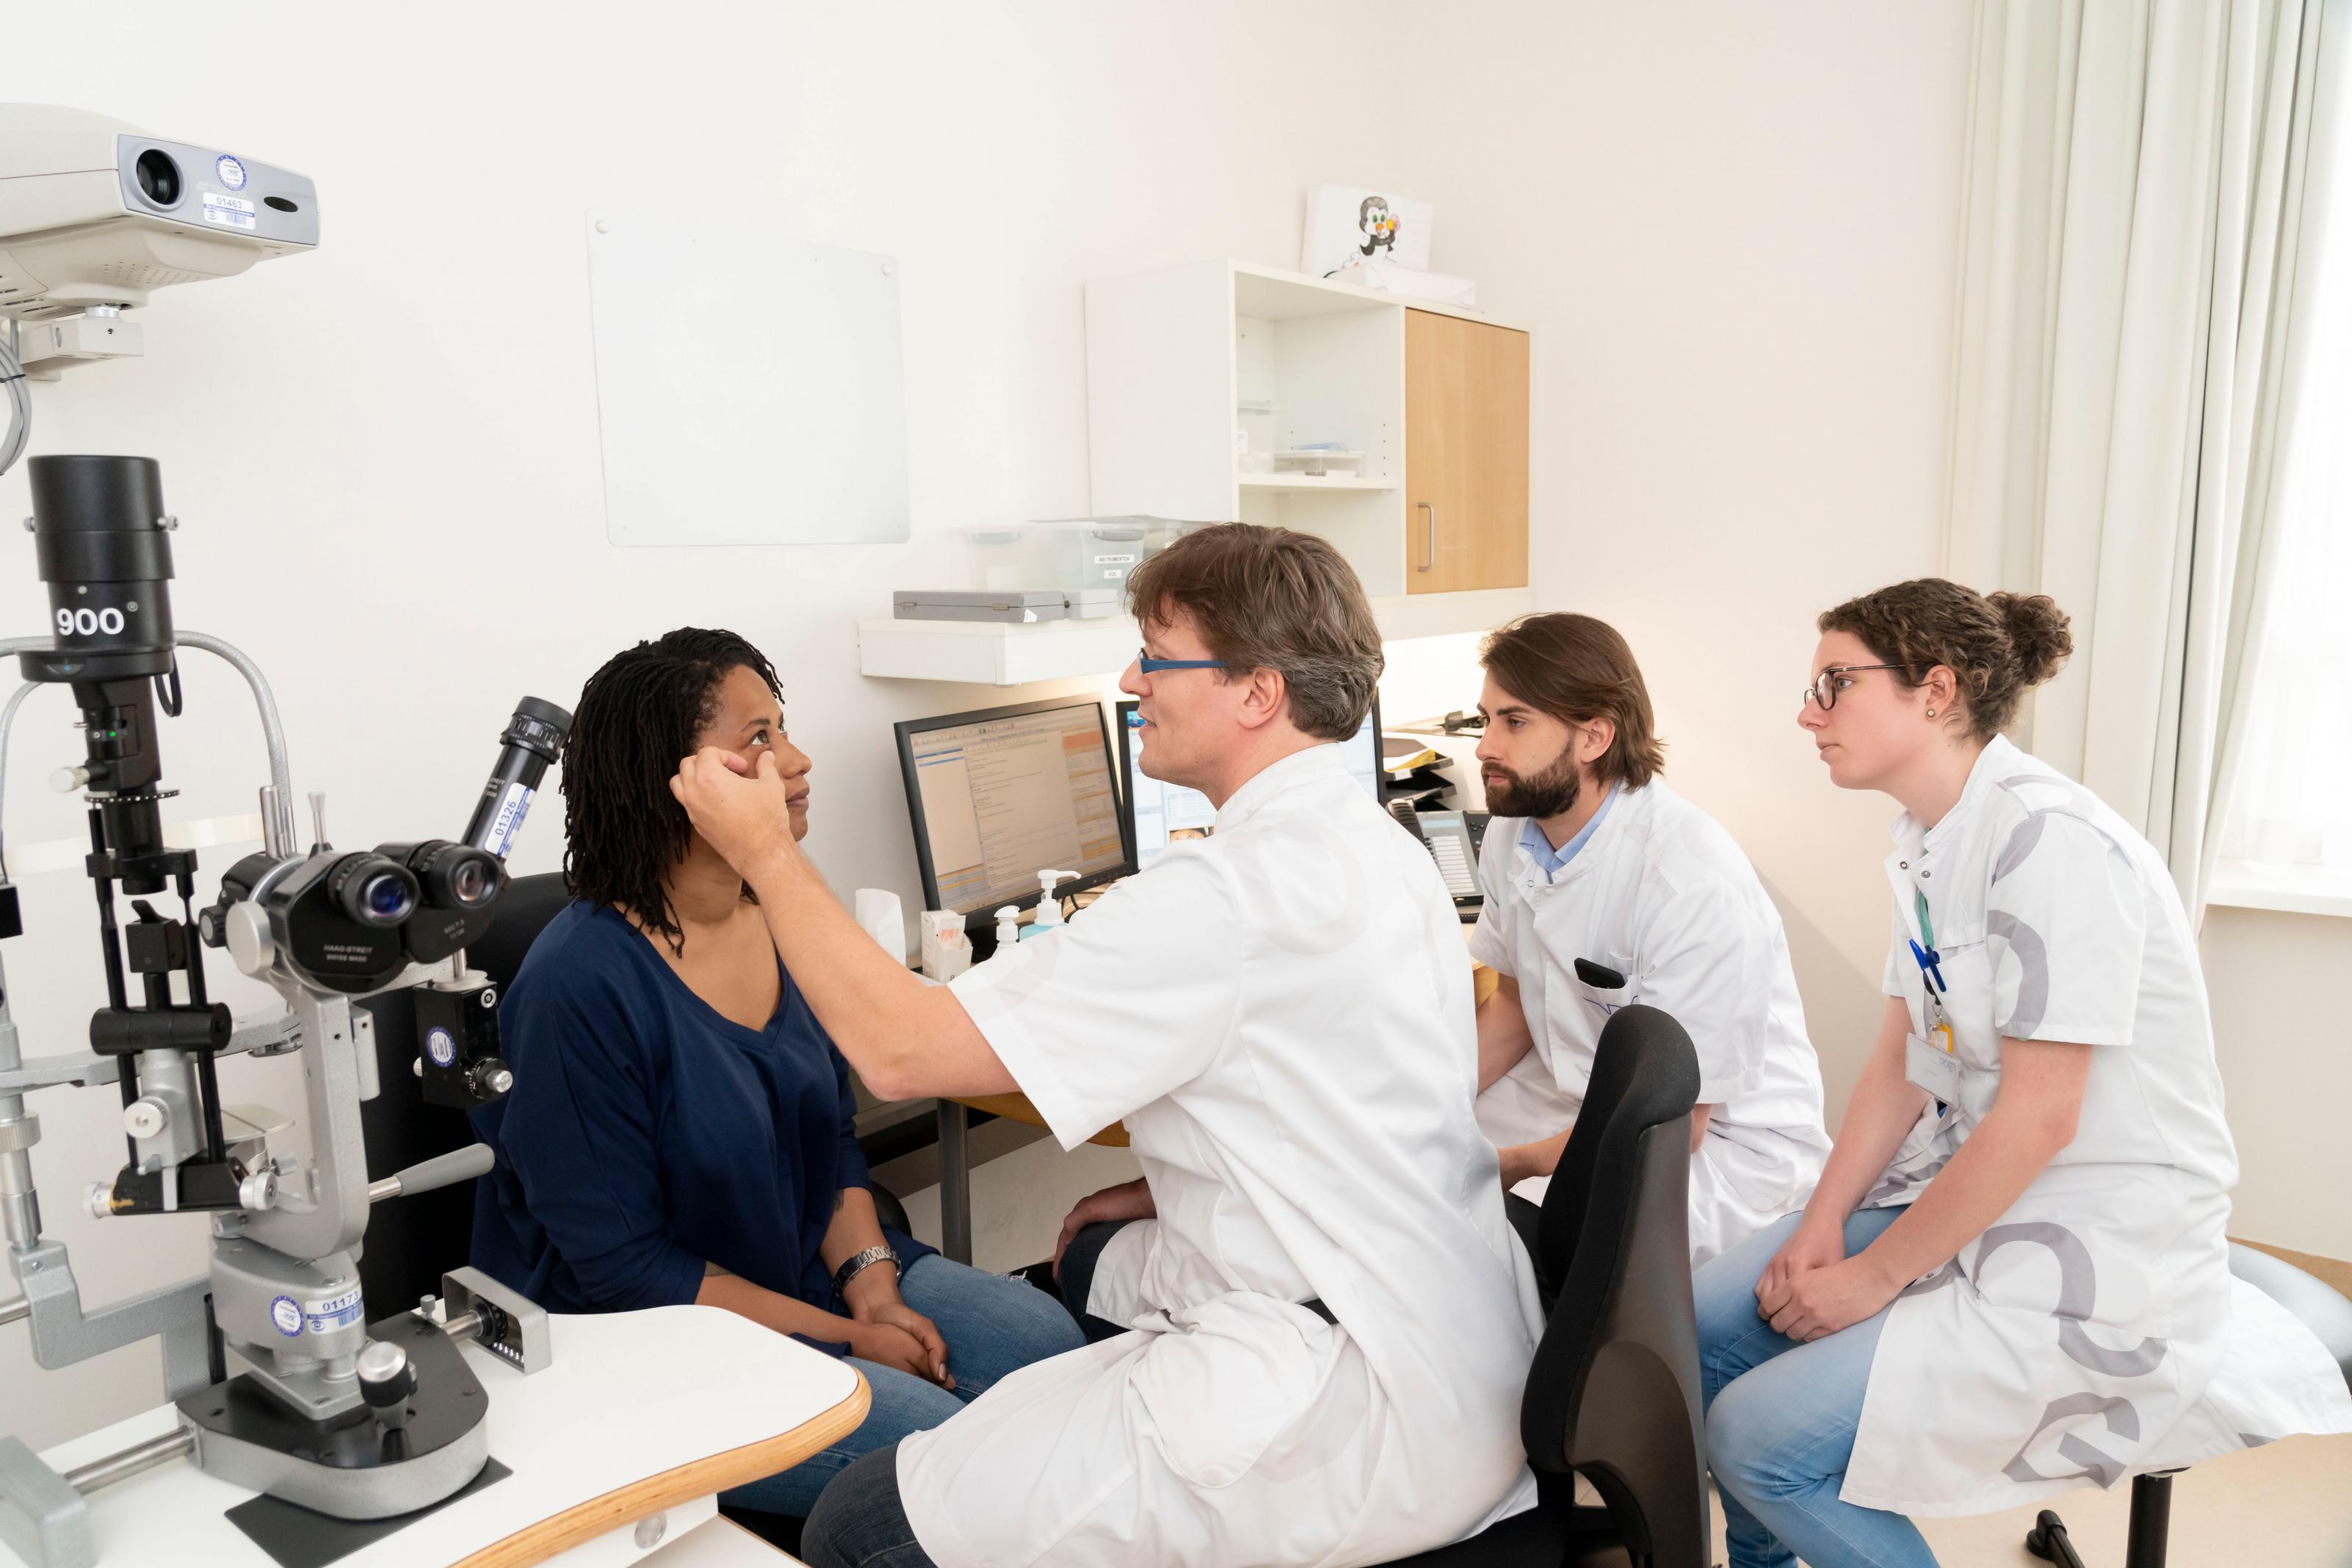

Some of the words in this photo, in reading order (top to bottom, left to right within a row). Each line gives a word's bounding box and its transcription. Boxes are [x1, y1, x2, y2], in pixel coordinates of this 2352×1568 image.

[217, 197, 243, 209] 01463
[57, 608, 125, 636] 900
[495, 801, 517, 835] 01326
[323, 945, 373, 954] HAAG-STREIT
[323, 1291, 359, 1312] 01173
